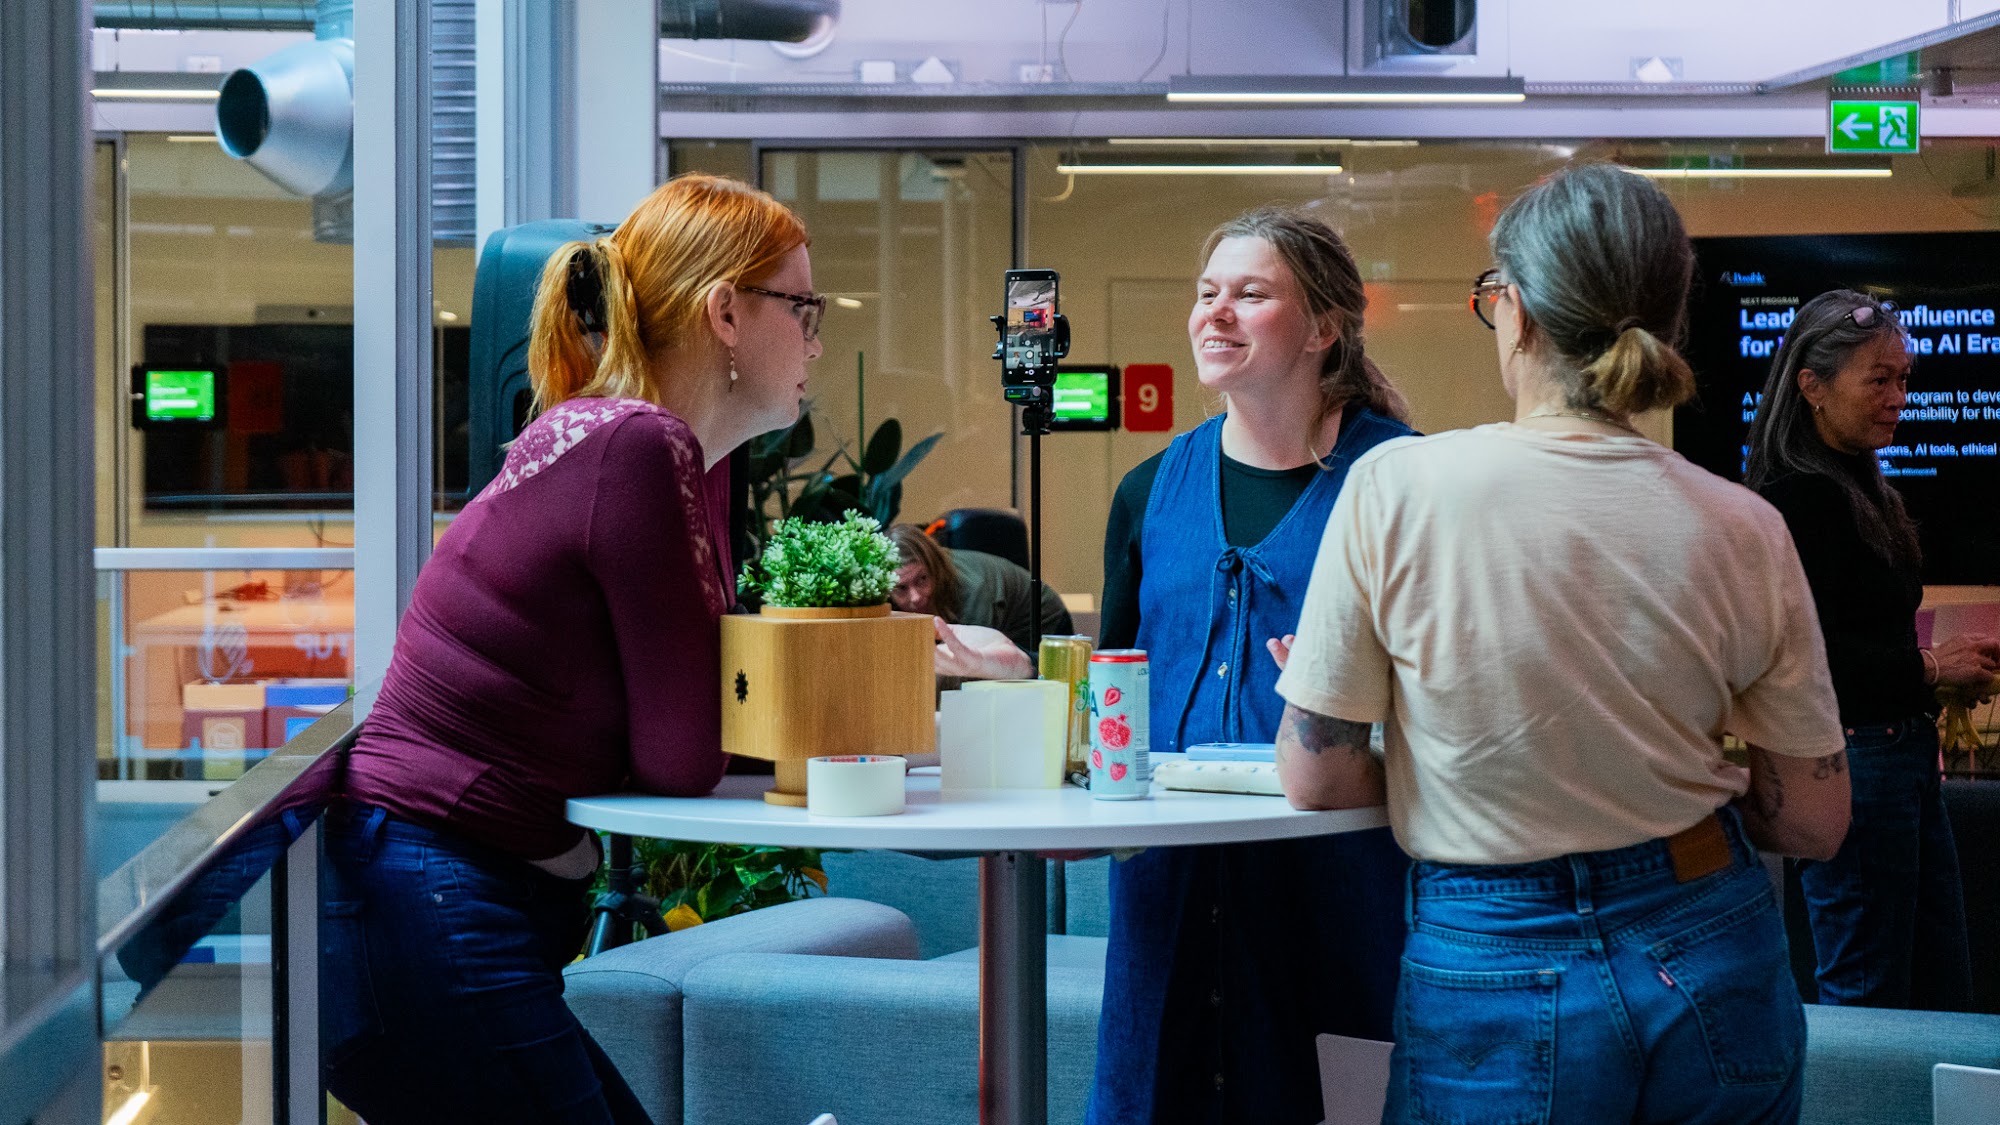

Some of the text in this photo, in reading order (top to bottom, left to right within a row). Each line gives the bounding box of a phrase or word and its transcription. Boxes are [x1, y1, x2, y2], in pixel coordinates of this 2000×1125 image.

[1740, 296, 1799, 306] NEXT PROGRAM
[1740, 304, 1995, 329] Lead nfluence
[1740, 335, 1774, 357] for
[1937, 333, 1961, 354] AI
[1967, 333, 2000, 354] Era
[1137, 383, 1159, 413] 9
[1742, 391, 1754, 406] A
[1956, 389, 1970, 404] to
[1962, 405, 1981, 421] for
[1914, 443, 1927, 456] AI
[1929, 443, 1959, 457] tools,
[1961, 442, 1998, 456] ethical
